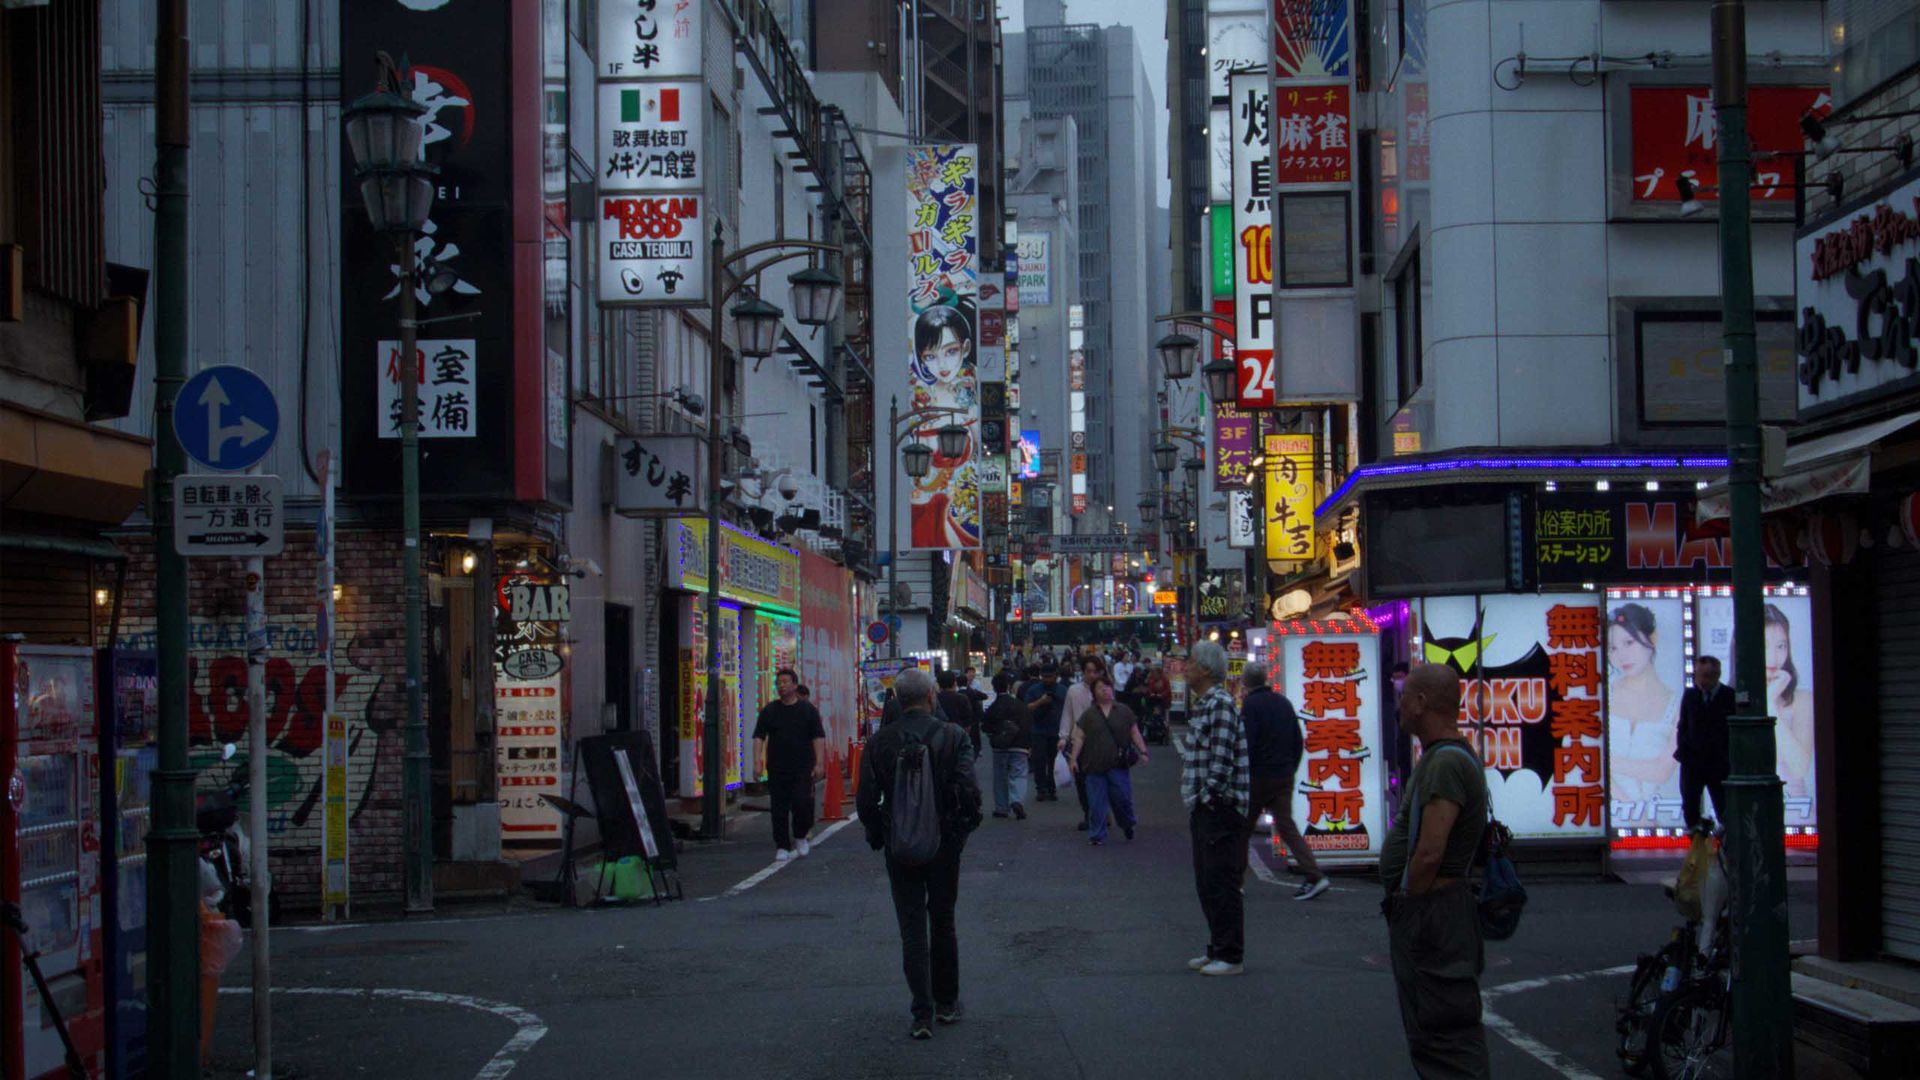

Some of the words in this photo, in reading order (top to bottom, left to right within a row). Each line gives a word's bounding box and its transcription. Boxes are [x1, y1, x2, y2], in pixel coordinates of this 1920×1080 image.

[608, 63, 624, 74] 1F
[1288, 90, 1339, 107] リーチ
[613, 130, 688, 147] 歌舞伎町
[1278, 112, 1348, 151] 麻雀
[606, 151, 697, 179] メキシコ食堂
[1281, 155, 1345, 169] プラスワン
[604, 198, 698, 219] MEXICAN
[941, 156, 973, 273] ギラギラ
[619, 213, 683, 239] FOOD
[612, 243, 643, 259] CASA
[645, 241, 692, 258] TEQUILA
[914, 202, 942, 302] ガールズ
[1220, 427, 1248, 440] 3F
[621, 440, 691, 505] すし半
[183, 485, 272, 504] 自転車を除く
[183, 508, 273, 528] 一方通行
[1537, 509, 1612, 535] 俗案内所
[511, 585, 570, 621] BAR
[1547, 604, 1604, 827] 無料案内所
[1302, 641, 1364, 825] 無料案内所
